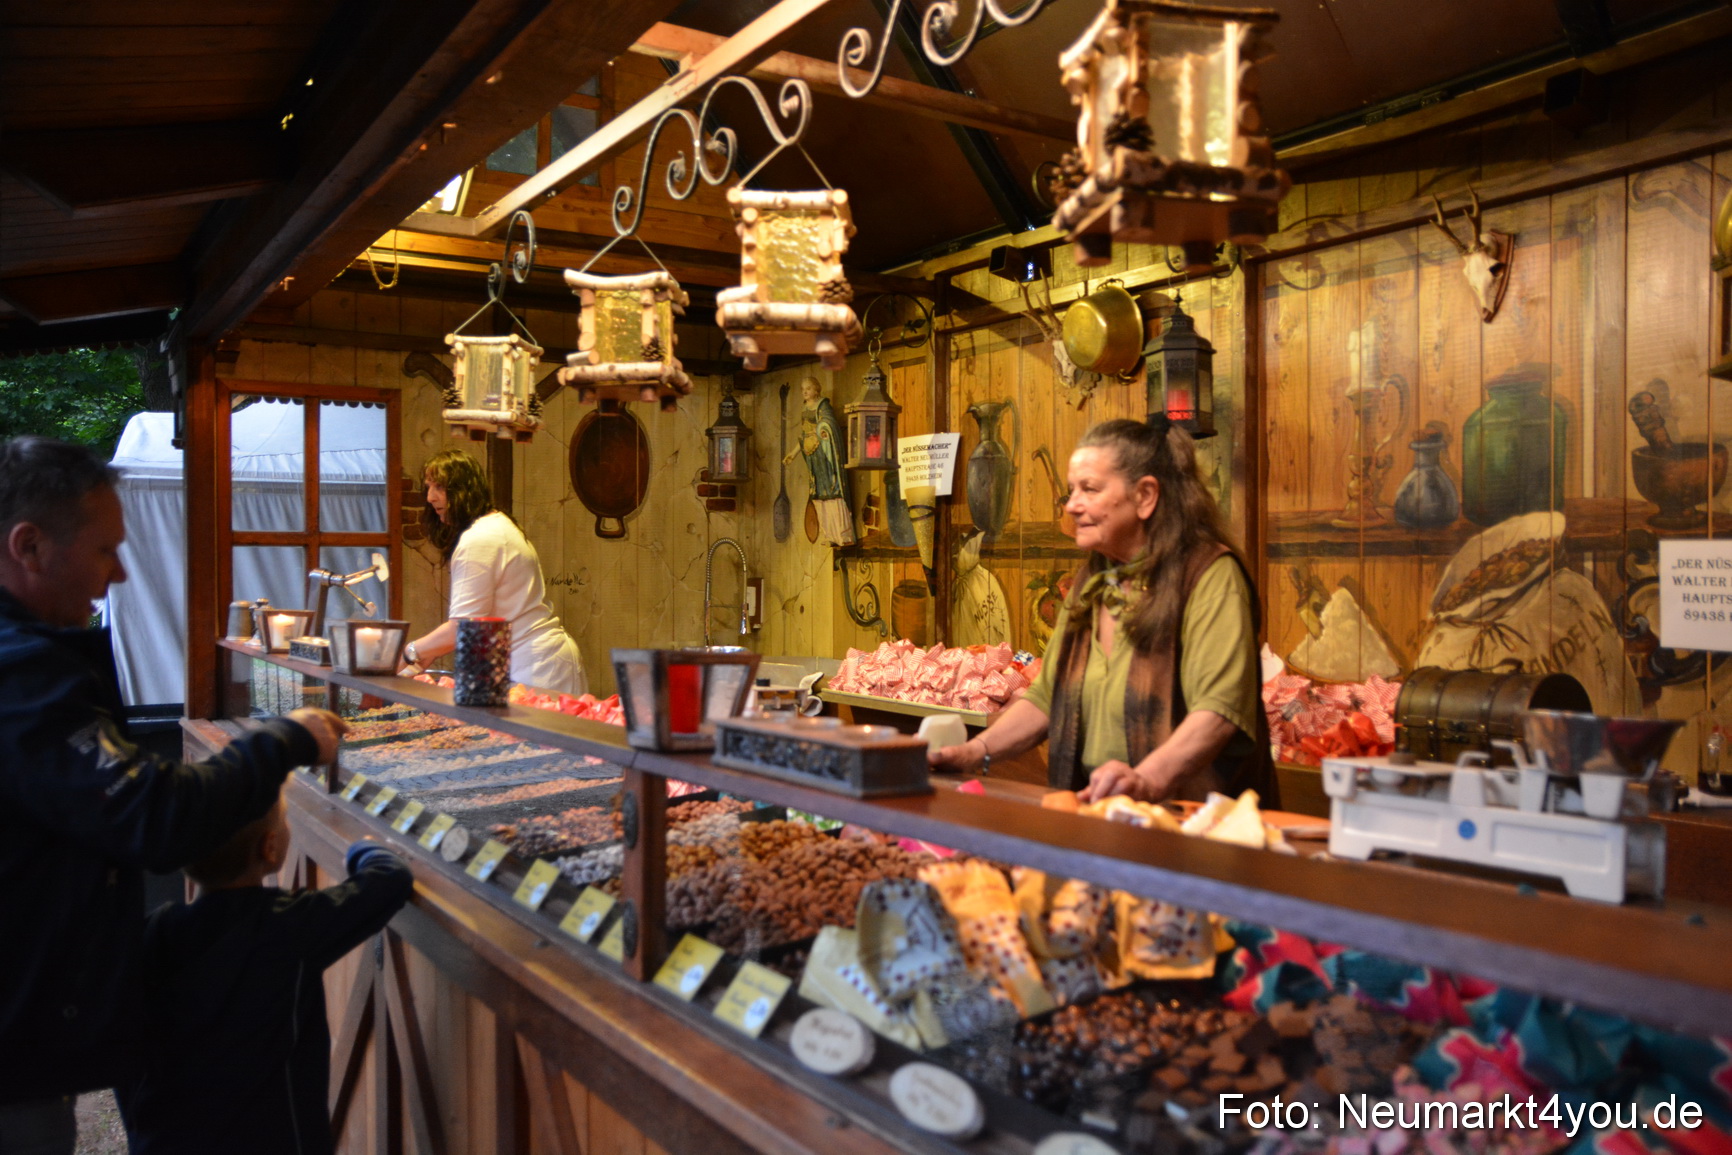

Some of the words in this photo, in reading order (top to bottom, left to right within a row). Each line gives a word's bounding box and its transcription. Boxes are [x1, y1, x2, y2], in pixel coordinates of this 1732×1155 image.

[1672, 575, 1727, 587] WALTER
[1684, 609, 1726, 621] 89438
[1527, 603, 1615, 675] ANDELN
